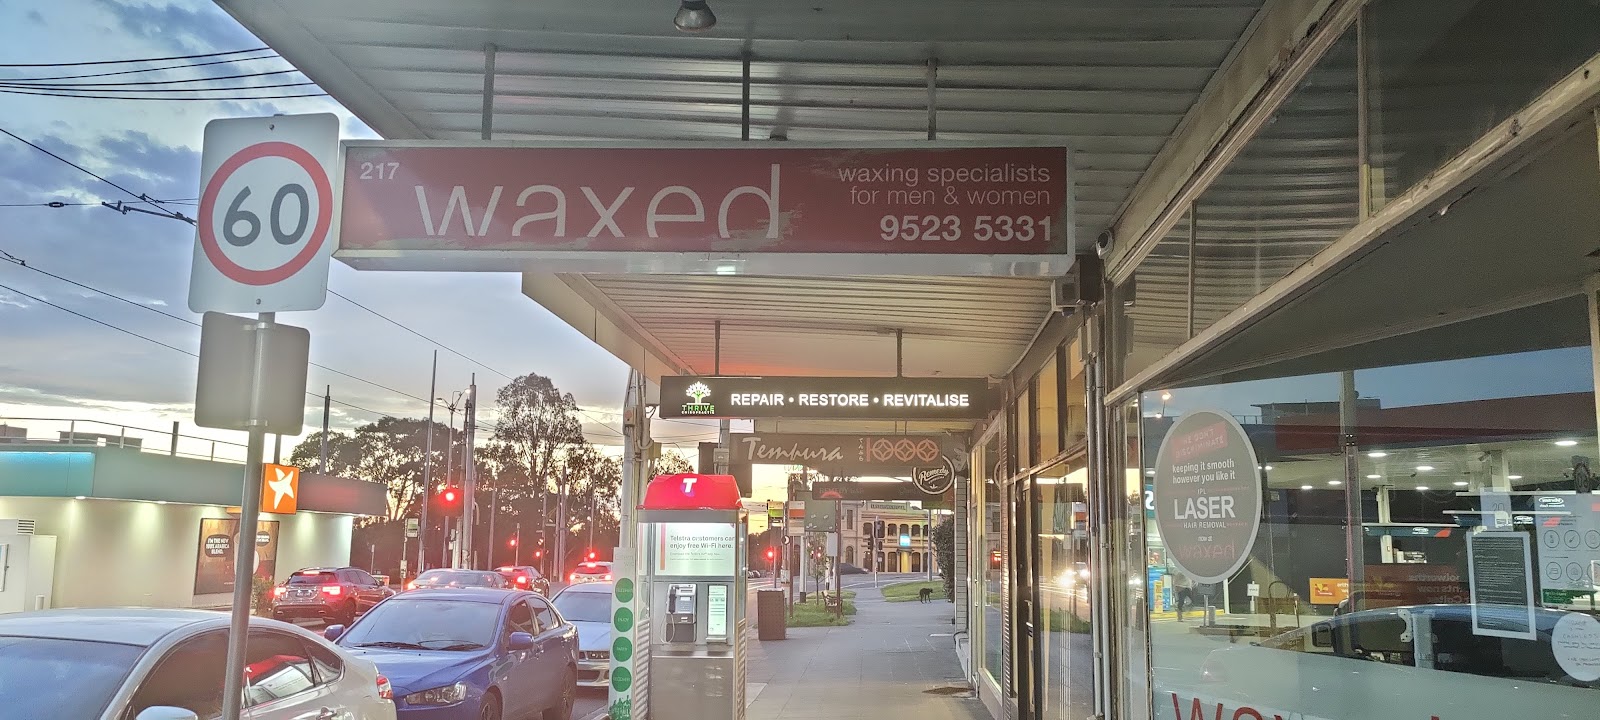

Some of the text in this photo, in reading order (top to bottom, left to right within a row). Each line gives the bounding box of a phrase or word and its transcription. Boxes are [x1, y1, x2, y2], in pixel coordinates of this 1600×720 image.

[360, 162, 399, 181] 217
[838, 163, 1050, 187] waxing specialists
[414, 163, 781, 239] waxed
[850, 185, 1050, 205] for men & women
[222, 182, 310, 248] 60
[880, 214, 1051, 242] 9523 5331
[730, 393, 970, 407] REPAIR RESTORE REVITALISE
[742, 436, 844, 461] Tempura
[918, 465, 950, 485] Remedy
[1172, 458, 1235, 474] keeping it smooth
[682, 477, 698, 493] T
[1172, 470, 1236, 485] however you like it
[1173, 495, 1236, 520] LASER
[1183, 521, 1226, 529] HAIR REMOVAL
